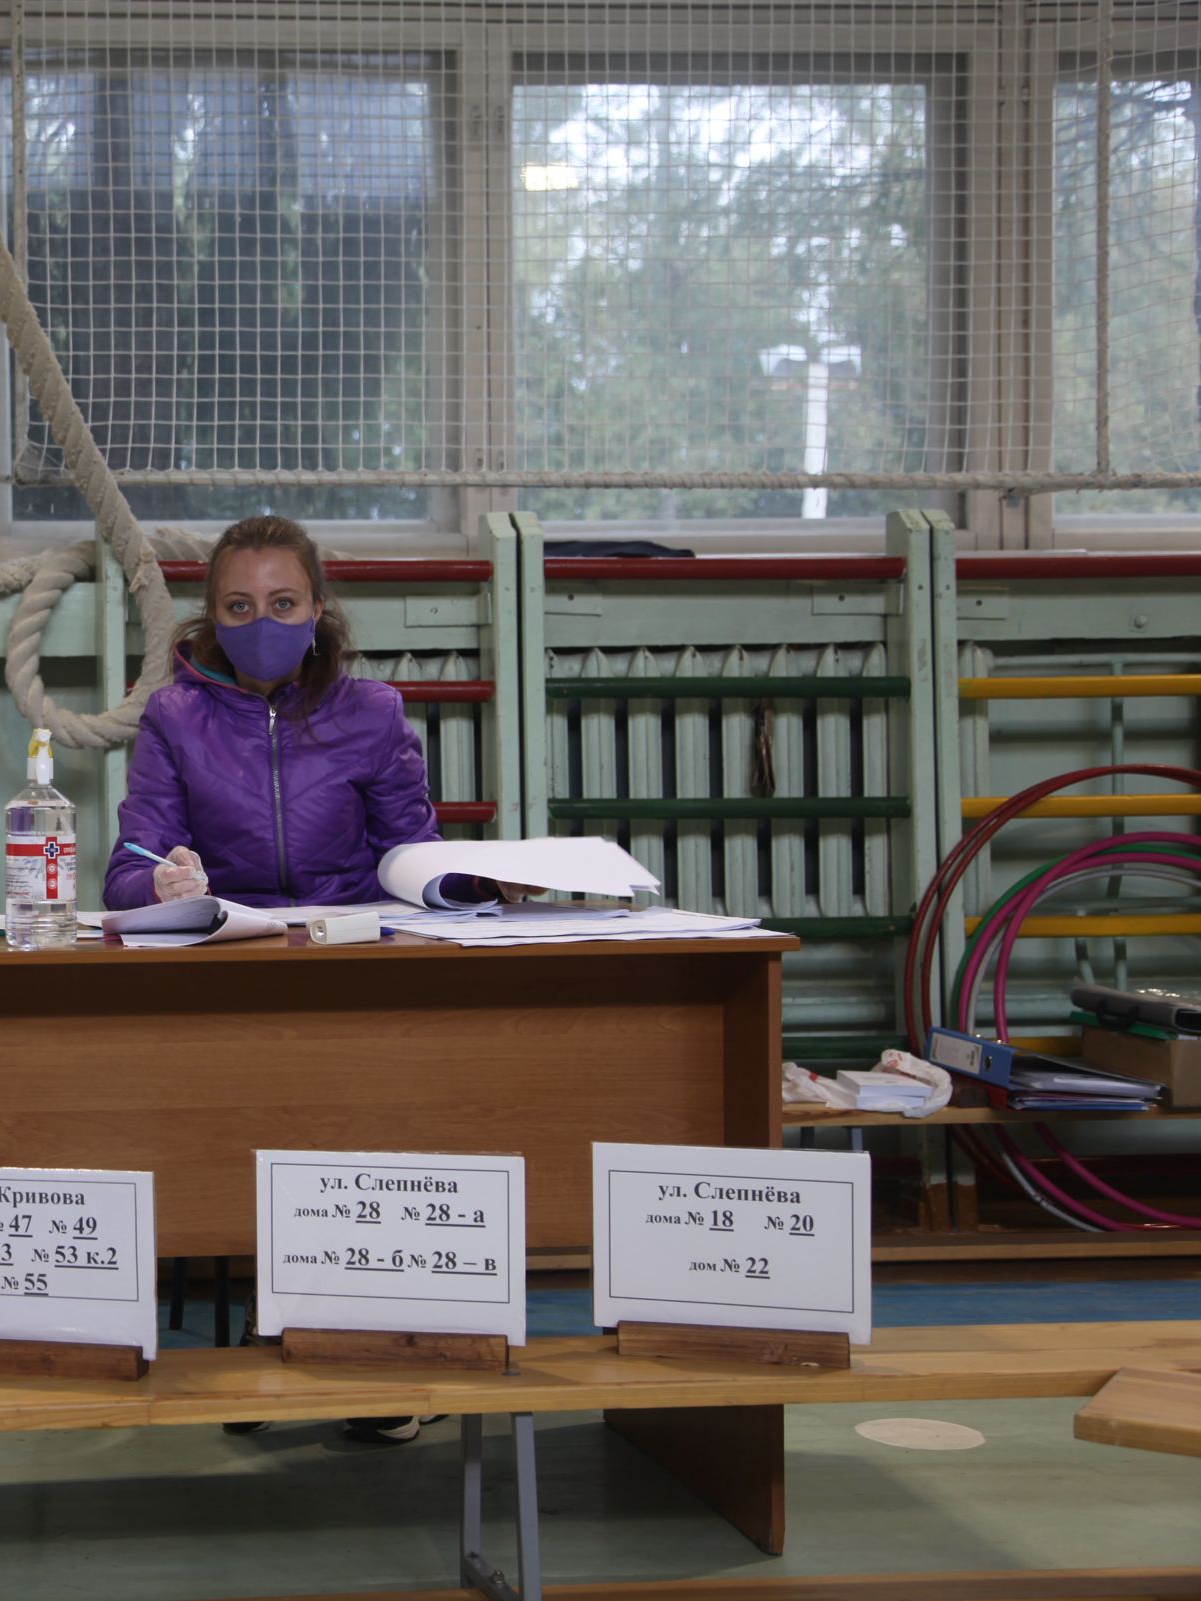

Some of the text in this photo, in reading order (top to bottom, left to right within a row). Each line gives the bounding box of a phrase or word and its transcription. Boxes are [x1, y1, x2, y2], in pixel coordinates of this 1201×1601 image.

[320, 1173, 458, 1193] ул. Слепнёва
[658, 1181, 801, 1204] ул. Слепнёва
[294, 1207, 328, 1218] дома
[332, 1204, 351, 1218] №
[356, 1201, 381, 1219] 28
[401, 1207, 420, 1220] №
[9, 1214, 33, 1232] 47
[49, 1220, 67, 1233] №
[73, 1216, 97, 1235] 49
[646, 1210, 814, 1232] дома № 18 № 20
[31, 1249, 49, 1262] №
[283, 1253, 317, 1265] дома
[321, 1251, 340, 1265] №
[408, 1254, 426, 1268] №
[689, 1257, 769, 1275] дом № 22
[1, 1273, 48, 1291] № 55
